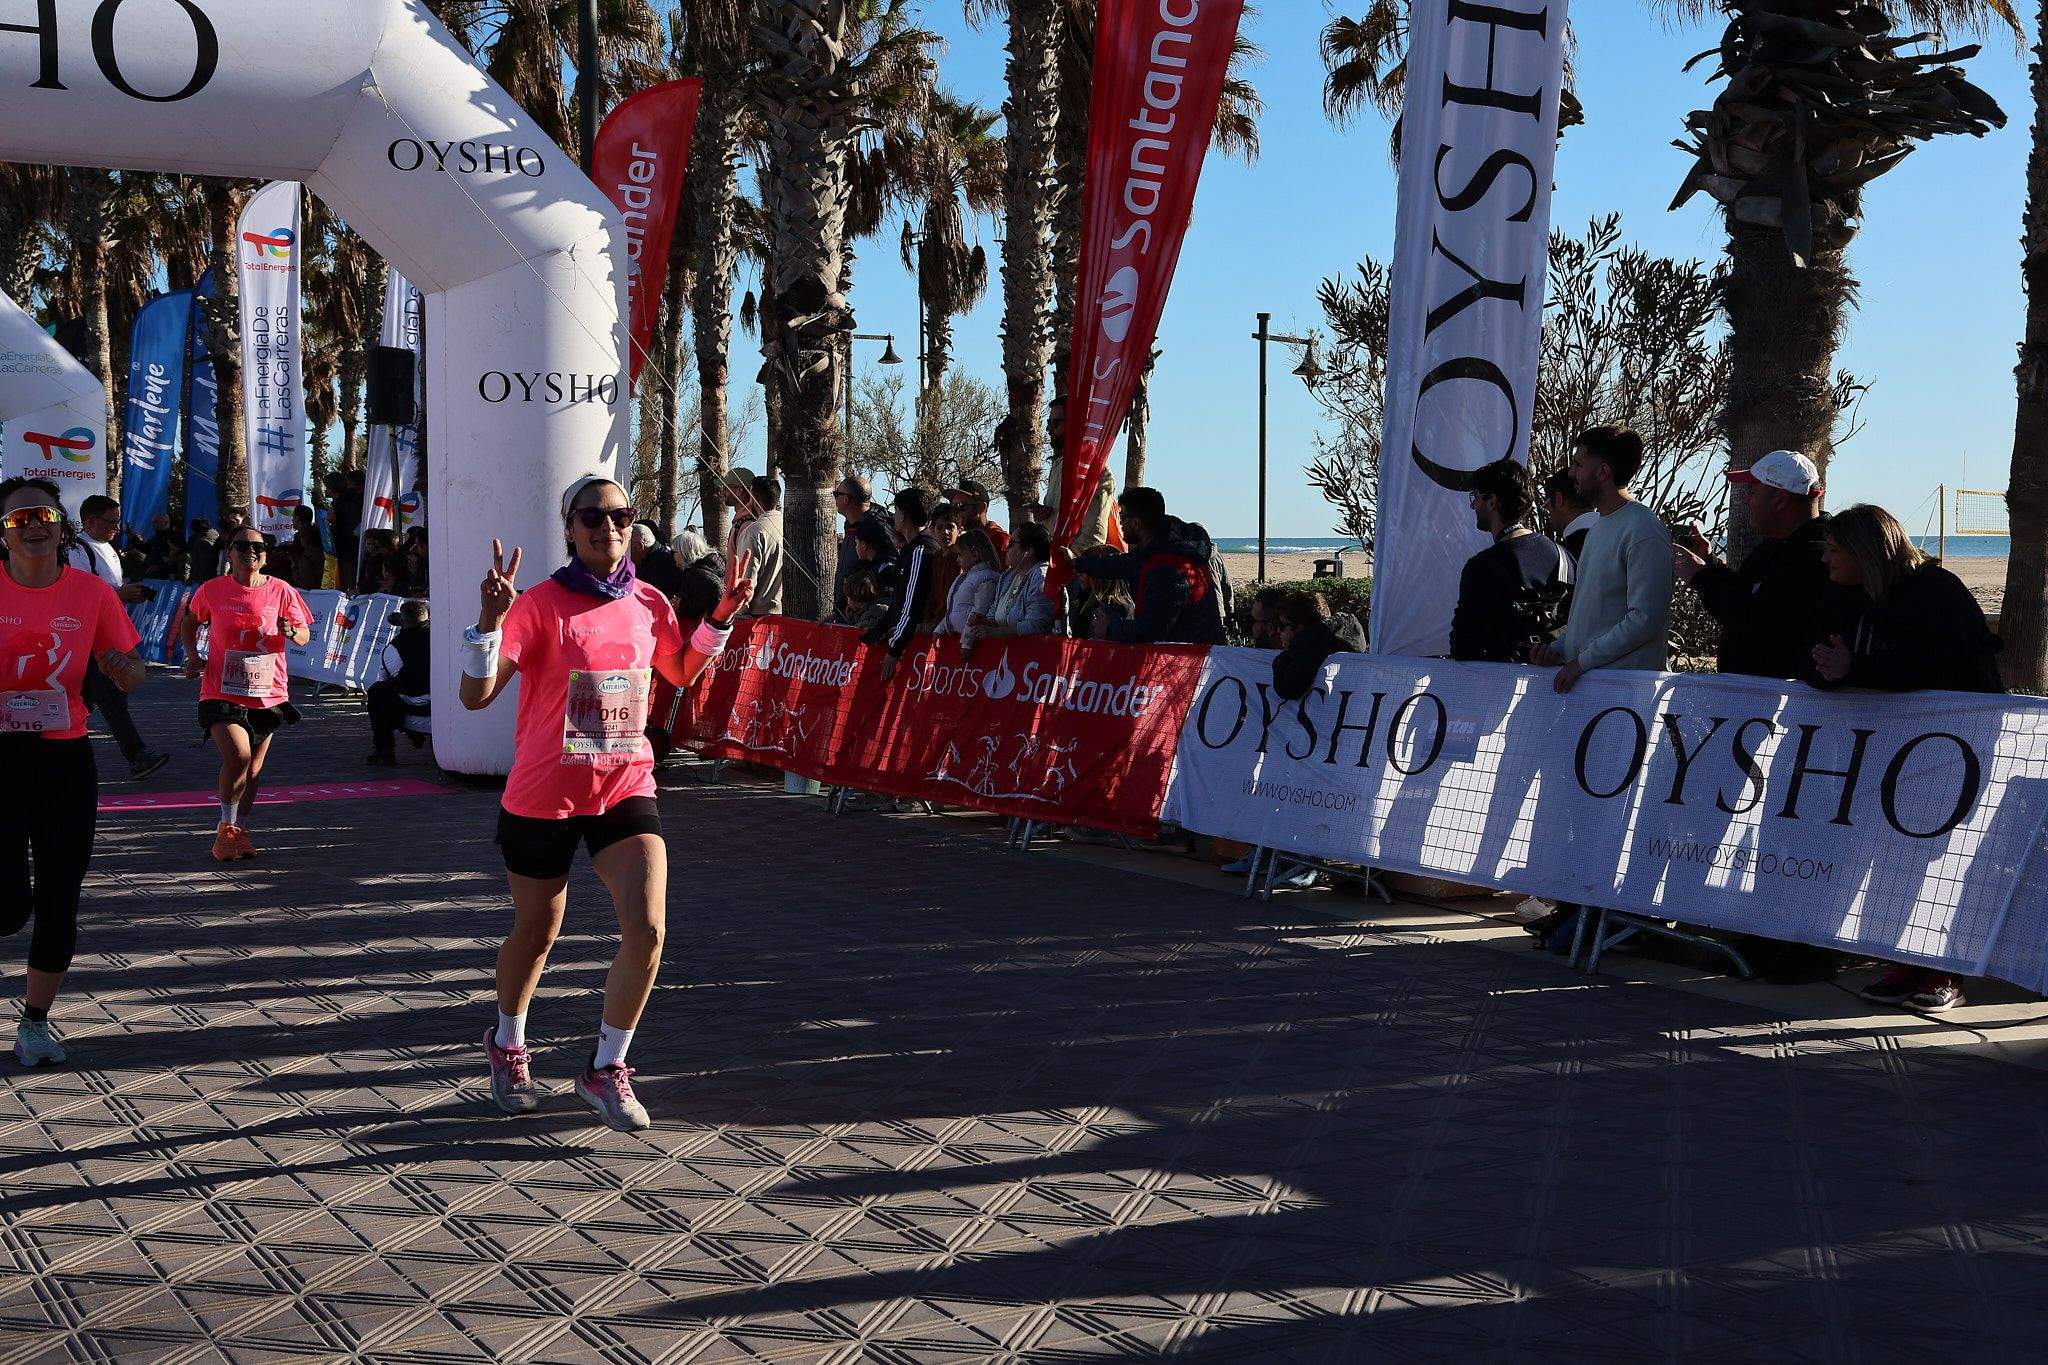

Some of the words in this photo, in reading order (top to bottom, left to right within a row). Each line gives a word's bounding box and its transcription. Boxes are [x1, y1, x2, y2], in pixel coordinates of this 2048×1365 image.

[387, 138, 546, 178] OYSHO
[273, 306, 292, 420] LasCarreras
[478, 371, 618, 405] OYSHO
[126, 362, 173, 470] Marlene
[22, 467, 96, 480] TotalEnergies
[711, 642, 754, 678] ports
[773, 642, 858, 687] Santander
[907, 652, 982, 702] Sports
[1016, 661, 1164, 718] Santander
[1197, 676, 1447, 775] OYSHO
[1574, 706, 1980, 839] OYSHO
[1241, 779, 1357, 812] WWW.OYSHO.COM
[1648, 837, 1833, 882] WWW.OYSHO.COM
